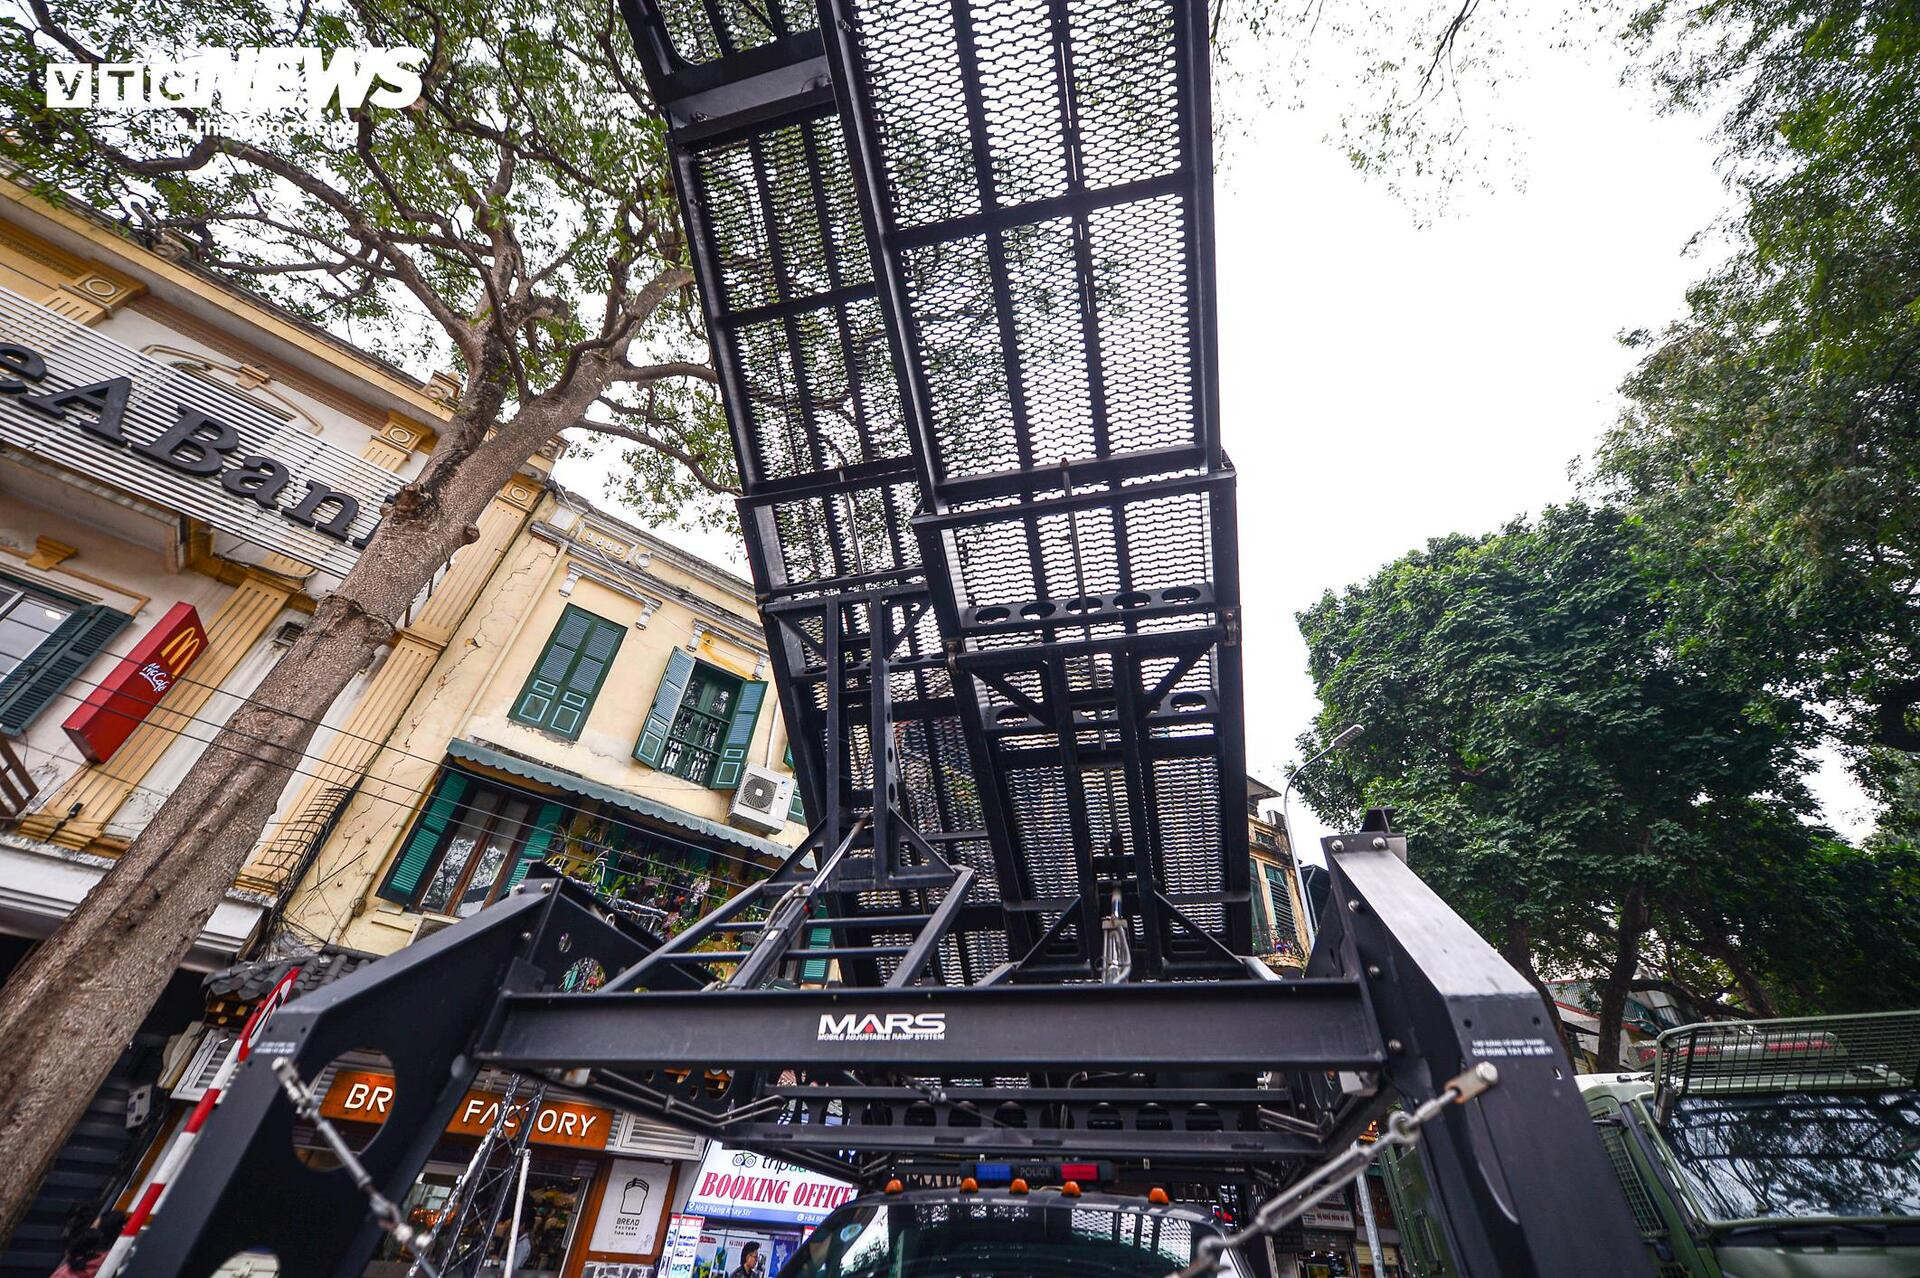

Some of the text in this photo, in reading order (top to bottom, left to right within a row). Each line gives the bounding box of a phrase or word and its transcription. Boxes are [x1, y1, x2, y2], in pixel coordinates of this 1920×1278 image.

[0, 342, 396, 550] eABan
[818, 1013, 946, 1034] MARS
[818, 1033, 945, 1041] MOBILE ADJUSTABLE RAMP SYSTEM
[462, 1099, 596, 1137] FACORY
[698, 1172, 790, 1204] BOOKING
[616, 1217, 640, 1226] BREAD
